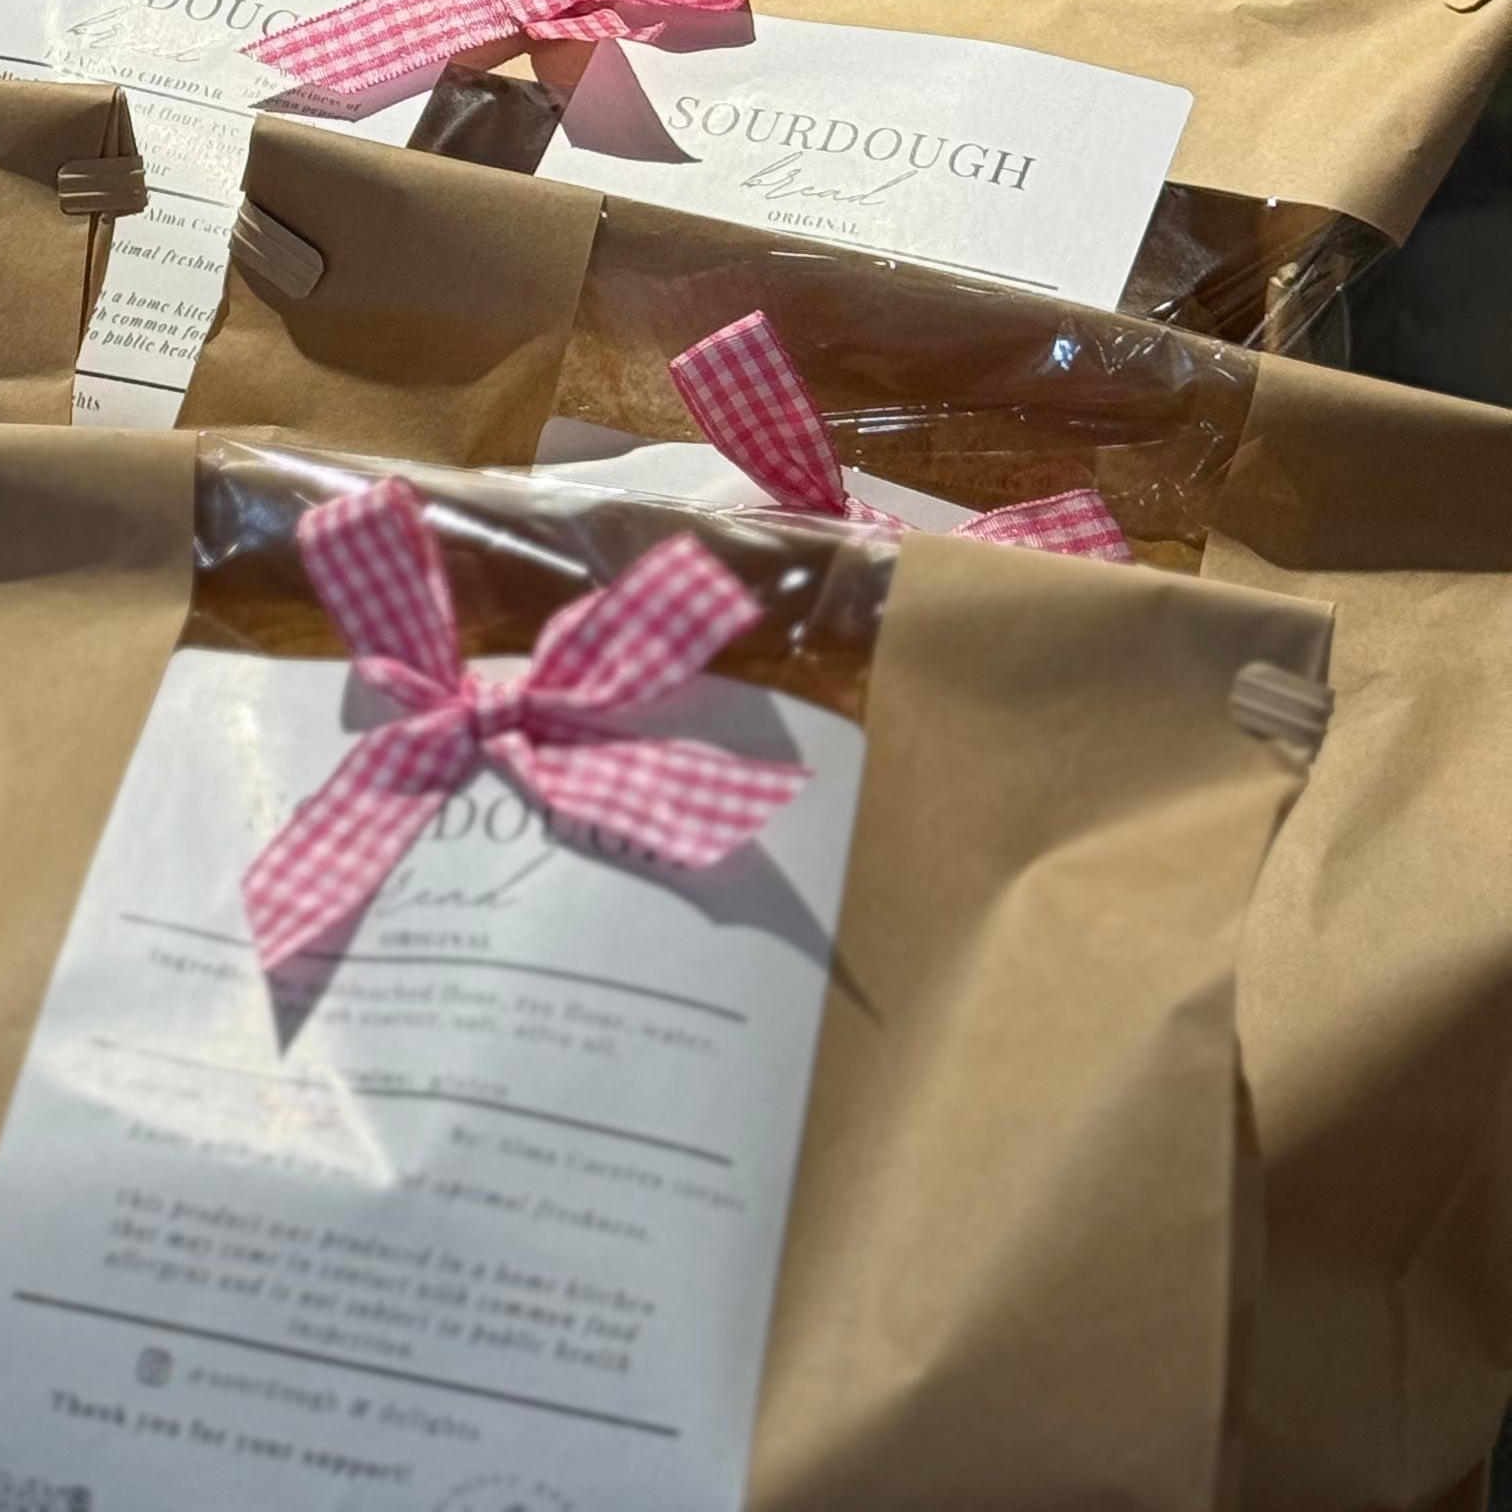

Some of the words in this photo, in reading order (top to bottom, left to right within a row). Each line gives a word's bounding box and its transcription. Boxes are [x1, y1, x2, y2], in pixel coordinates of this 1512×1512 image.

[666, 95, 1037, 191] SOURDOUGH
[739, 151, 918, 206] bread
[766, 209, 860, 237] ORIGINAL
